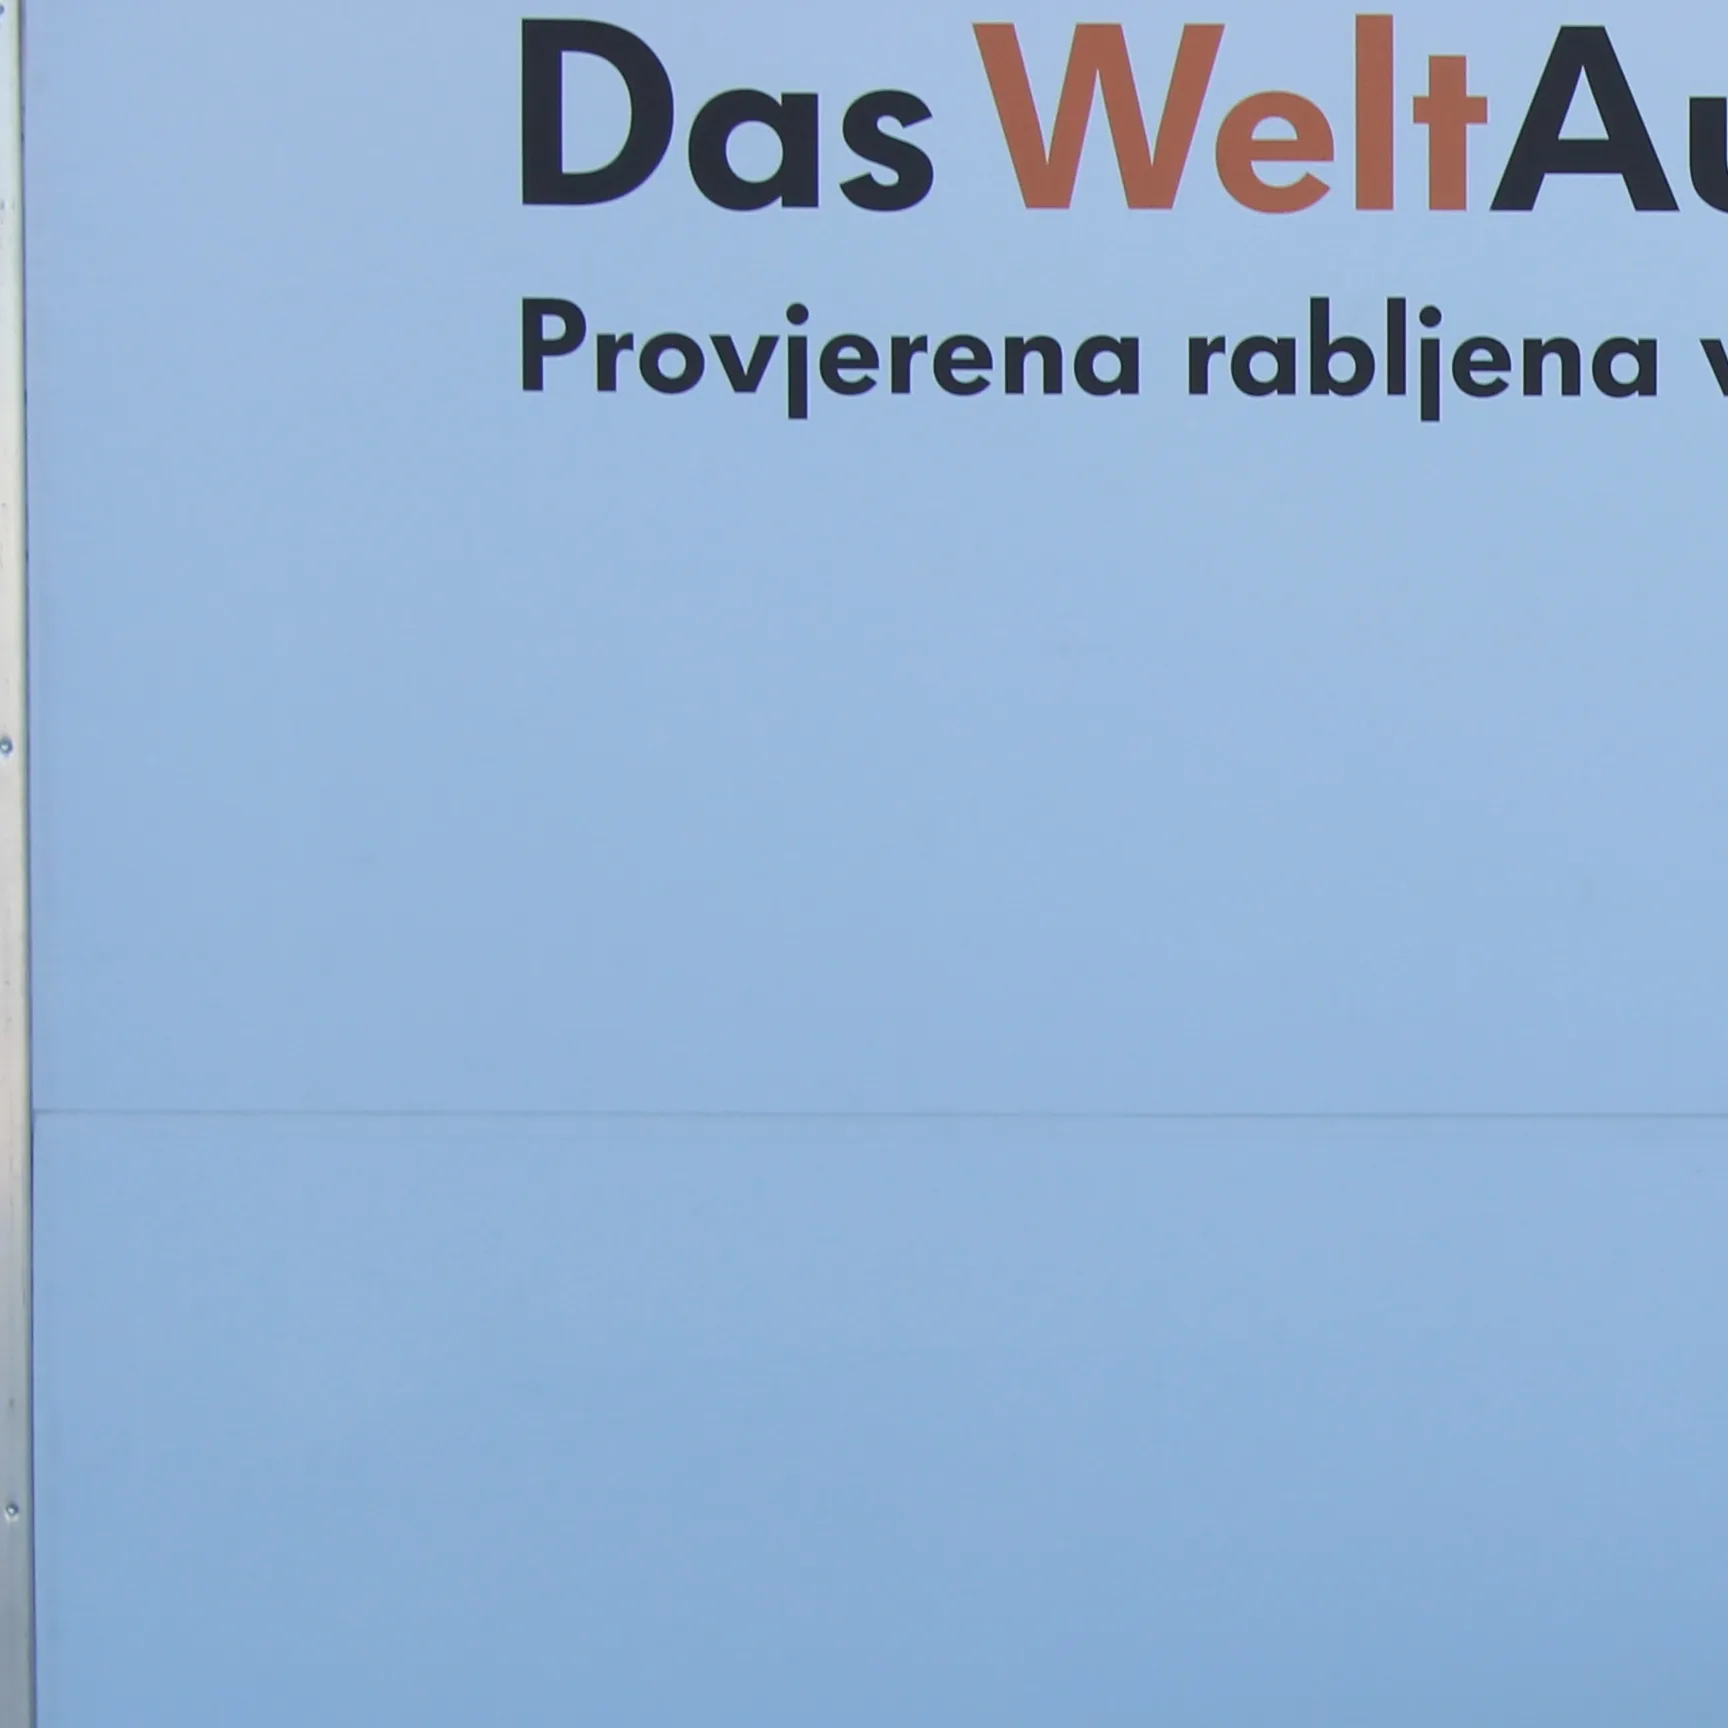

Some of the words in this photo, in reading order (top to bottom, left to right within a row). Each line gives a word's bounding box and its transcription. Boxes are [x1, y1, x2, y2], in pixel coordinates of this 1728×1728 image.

[520, 17, 935, 213] Das
[521, 296, 1140, 421] Provjerena
[1188, 296, 1659, 423] rabljena
